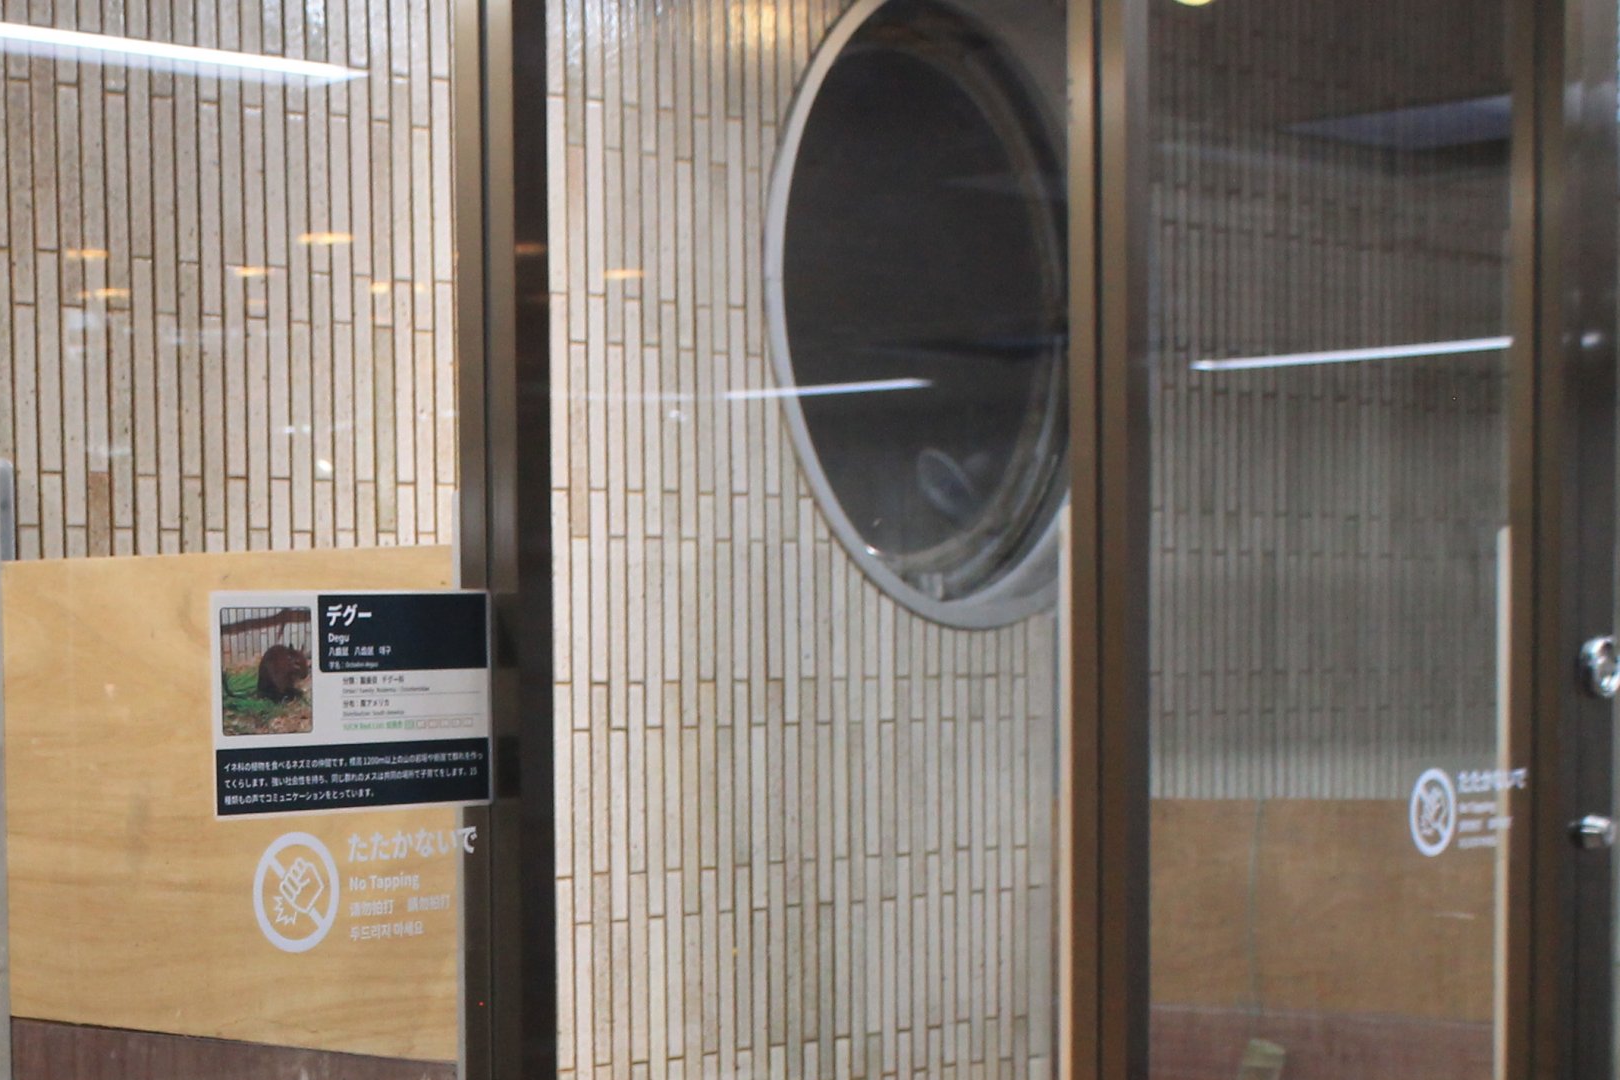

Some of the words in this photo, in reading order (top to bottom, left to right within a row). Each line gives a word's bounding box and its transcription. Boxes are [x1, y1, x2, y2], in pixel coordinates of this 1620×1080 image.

[326, 603, 372, 627] デグー
[327, 632, 350, 646] Degu
[347, 826, 478, 862] たたかないで
[349, 876, 366, 891] No
[370, 872, 420, 891] Tapping
